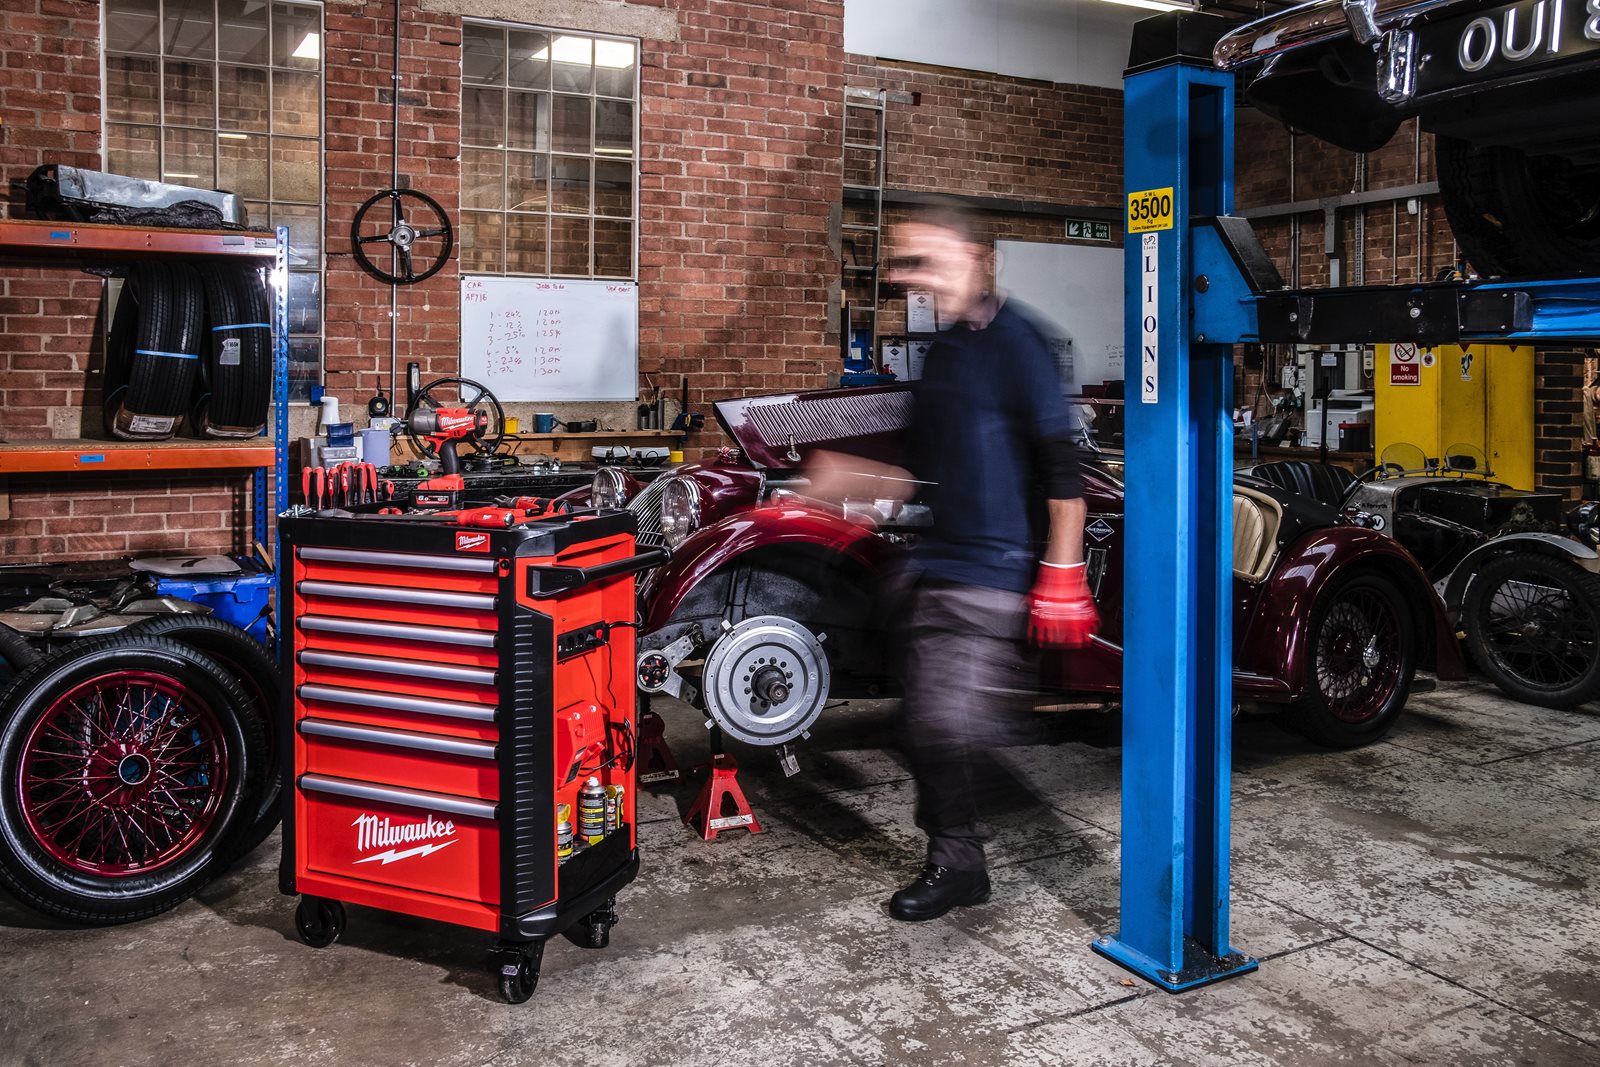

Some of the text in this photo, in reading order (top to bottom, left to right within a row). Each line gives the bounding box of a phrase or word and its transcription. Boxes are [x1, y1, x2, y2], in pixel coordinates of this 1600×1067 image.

[1130, 195, 1170, 221] 3500
[467, 281, 482, 289] CAR
[1143, 256, 1157, 394] LIONS
[1392, 374, 1418, 382] smoking
[457, 534, 486, 546] Milwaukee
[350, 812, 457, 852] Milwaukee
